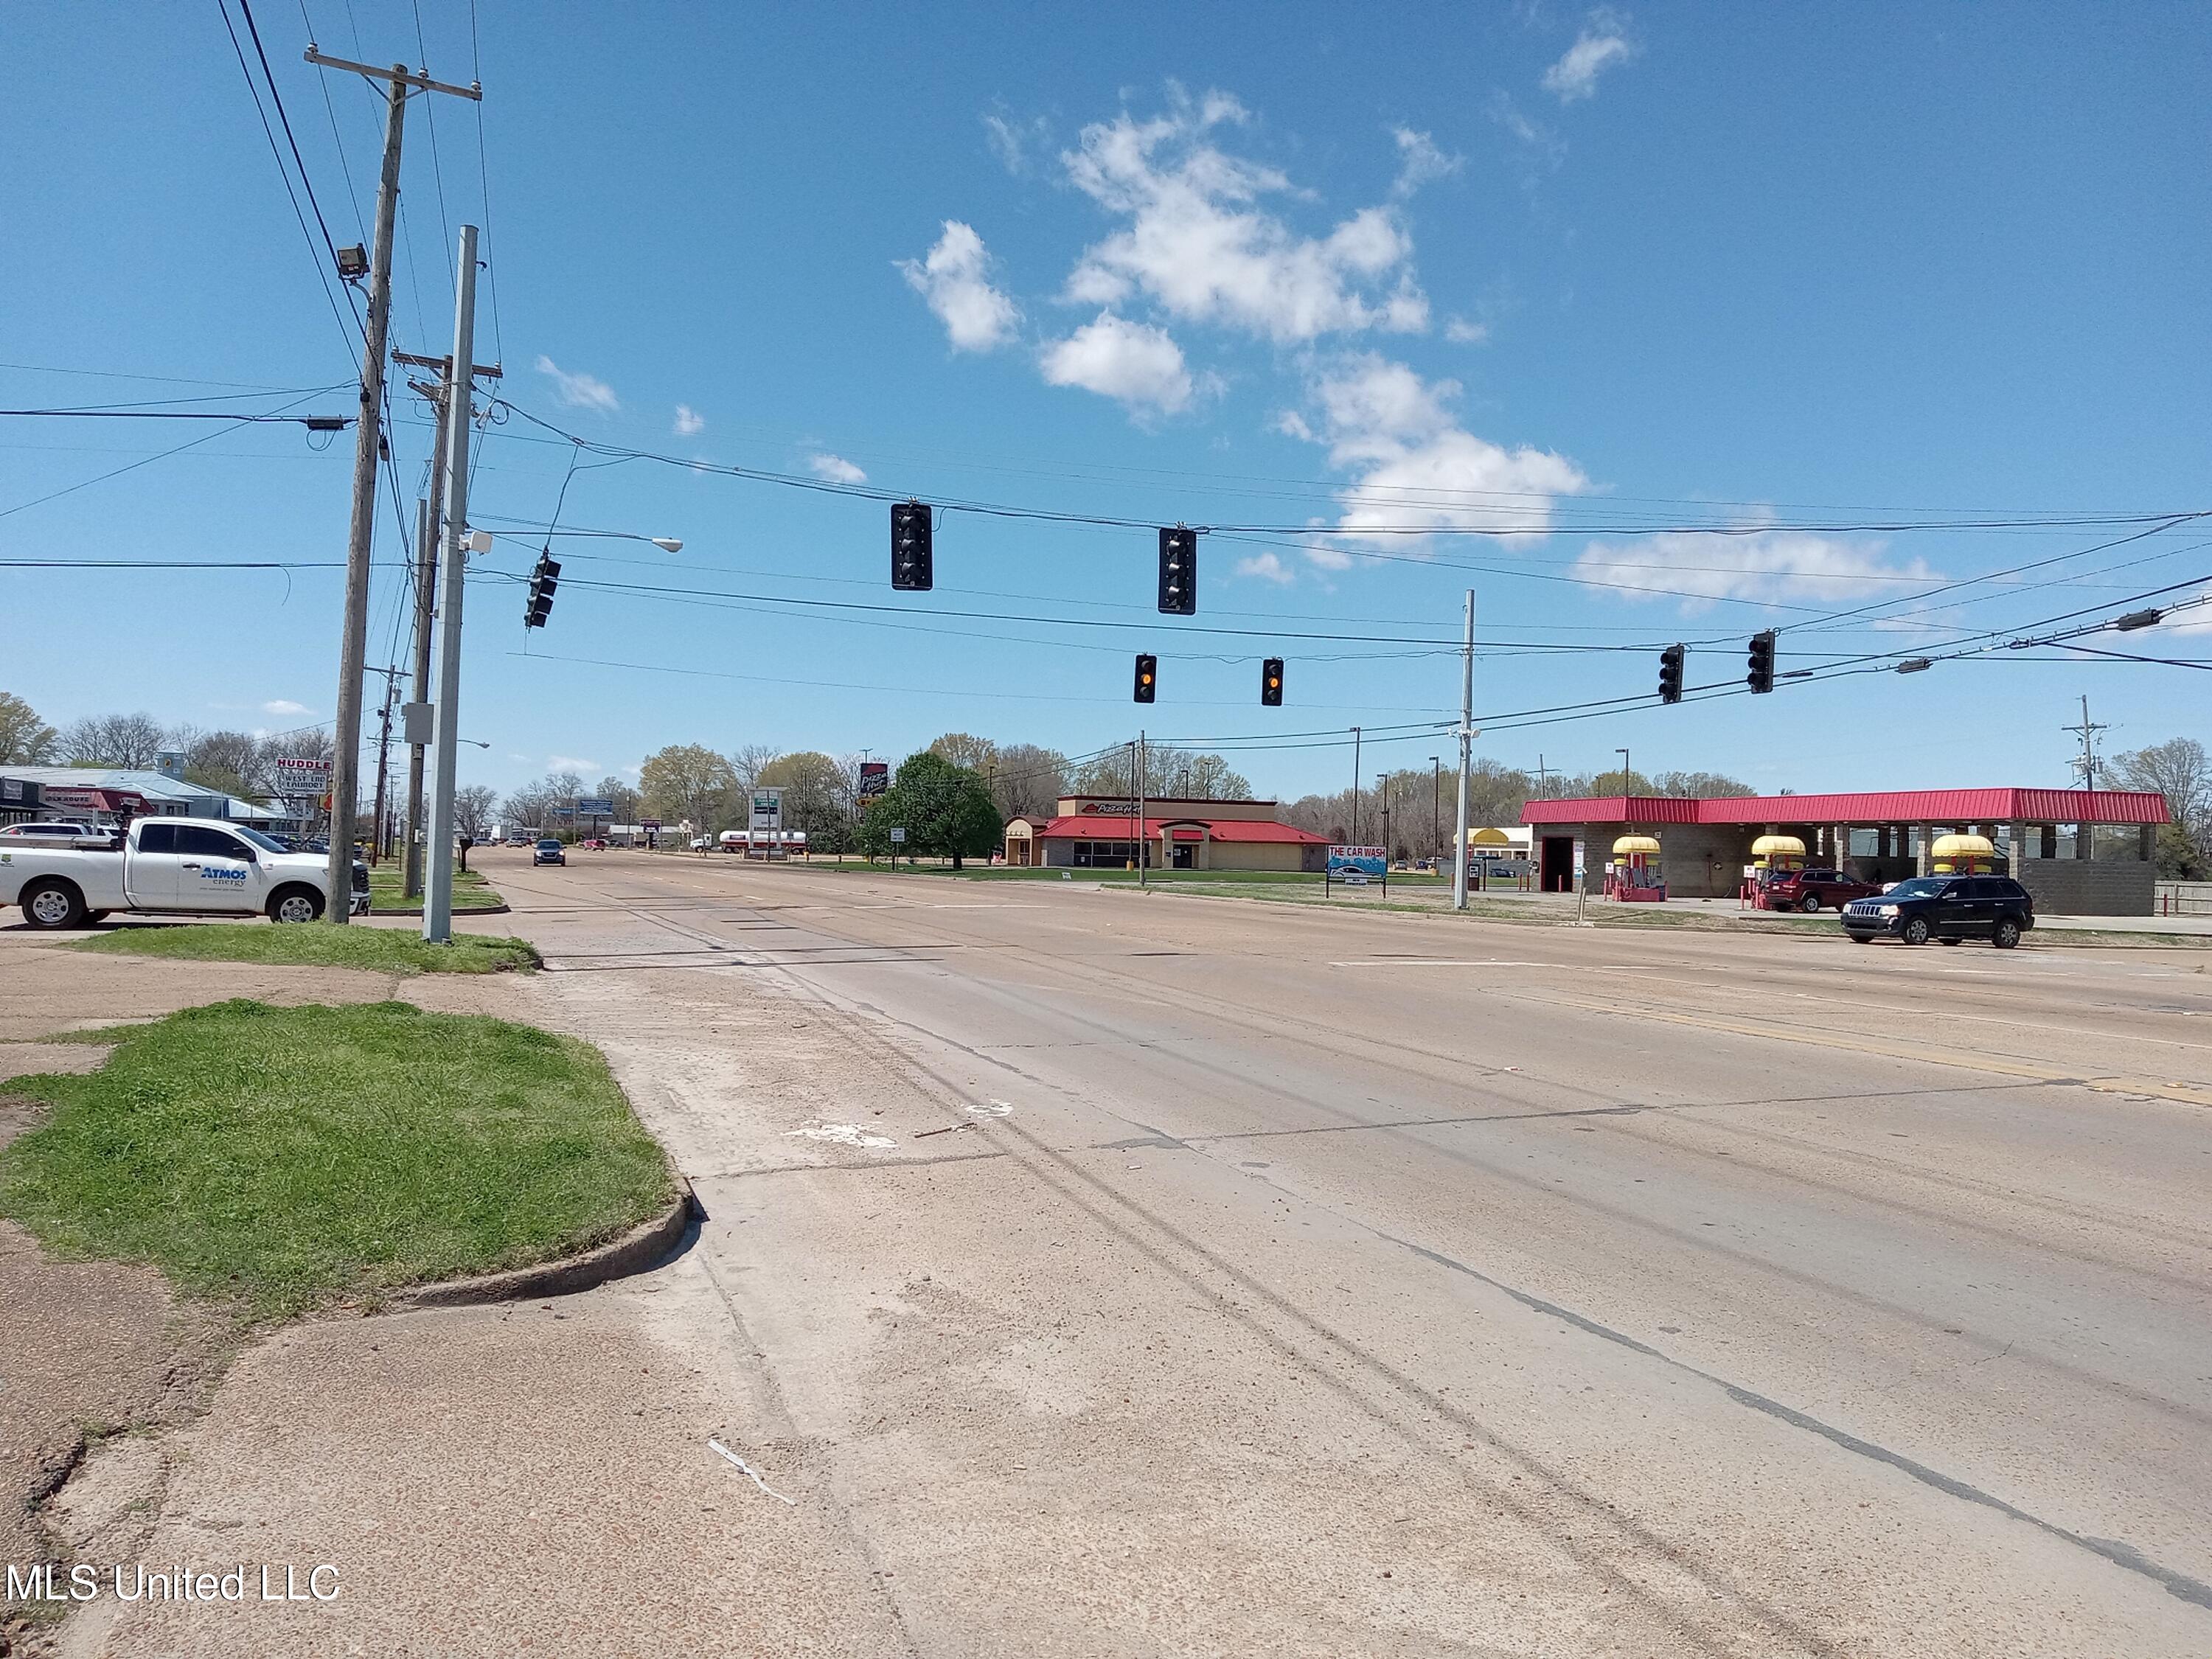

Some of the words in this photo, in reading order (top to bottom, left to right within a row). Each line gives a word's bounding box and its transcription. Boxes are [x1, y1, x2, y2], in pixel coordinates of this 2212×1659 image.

[277, 759, 331, 770] HUDDLE
[860, 773, 887, 789] Pizza
[866, 779, 884, 791] Hut
[1097, 804, 1123, 813] Pizza
[1329, 846, 1344, 856] THE
[1346, 847, 1363, 857] CAR
[1364, 848, 1385, 857] WASH
[201, 867, 246, 880] ATMOS
